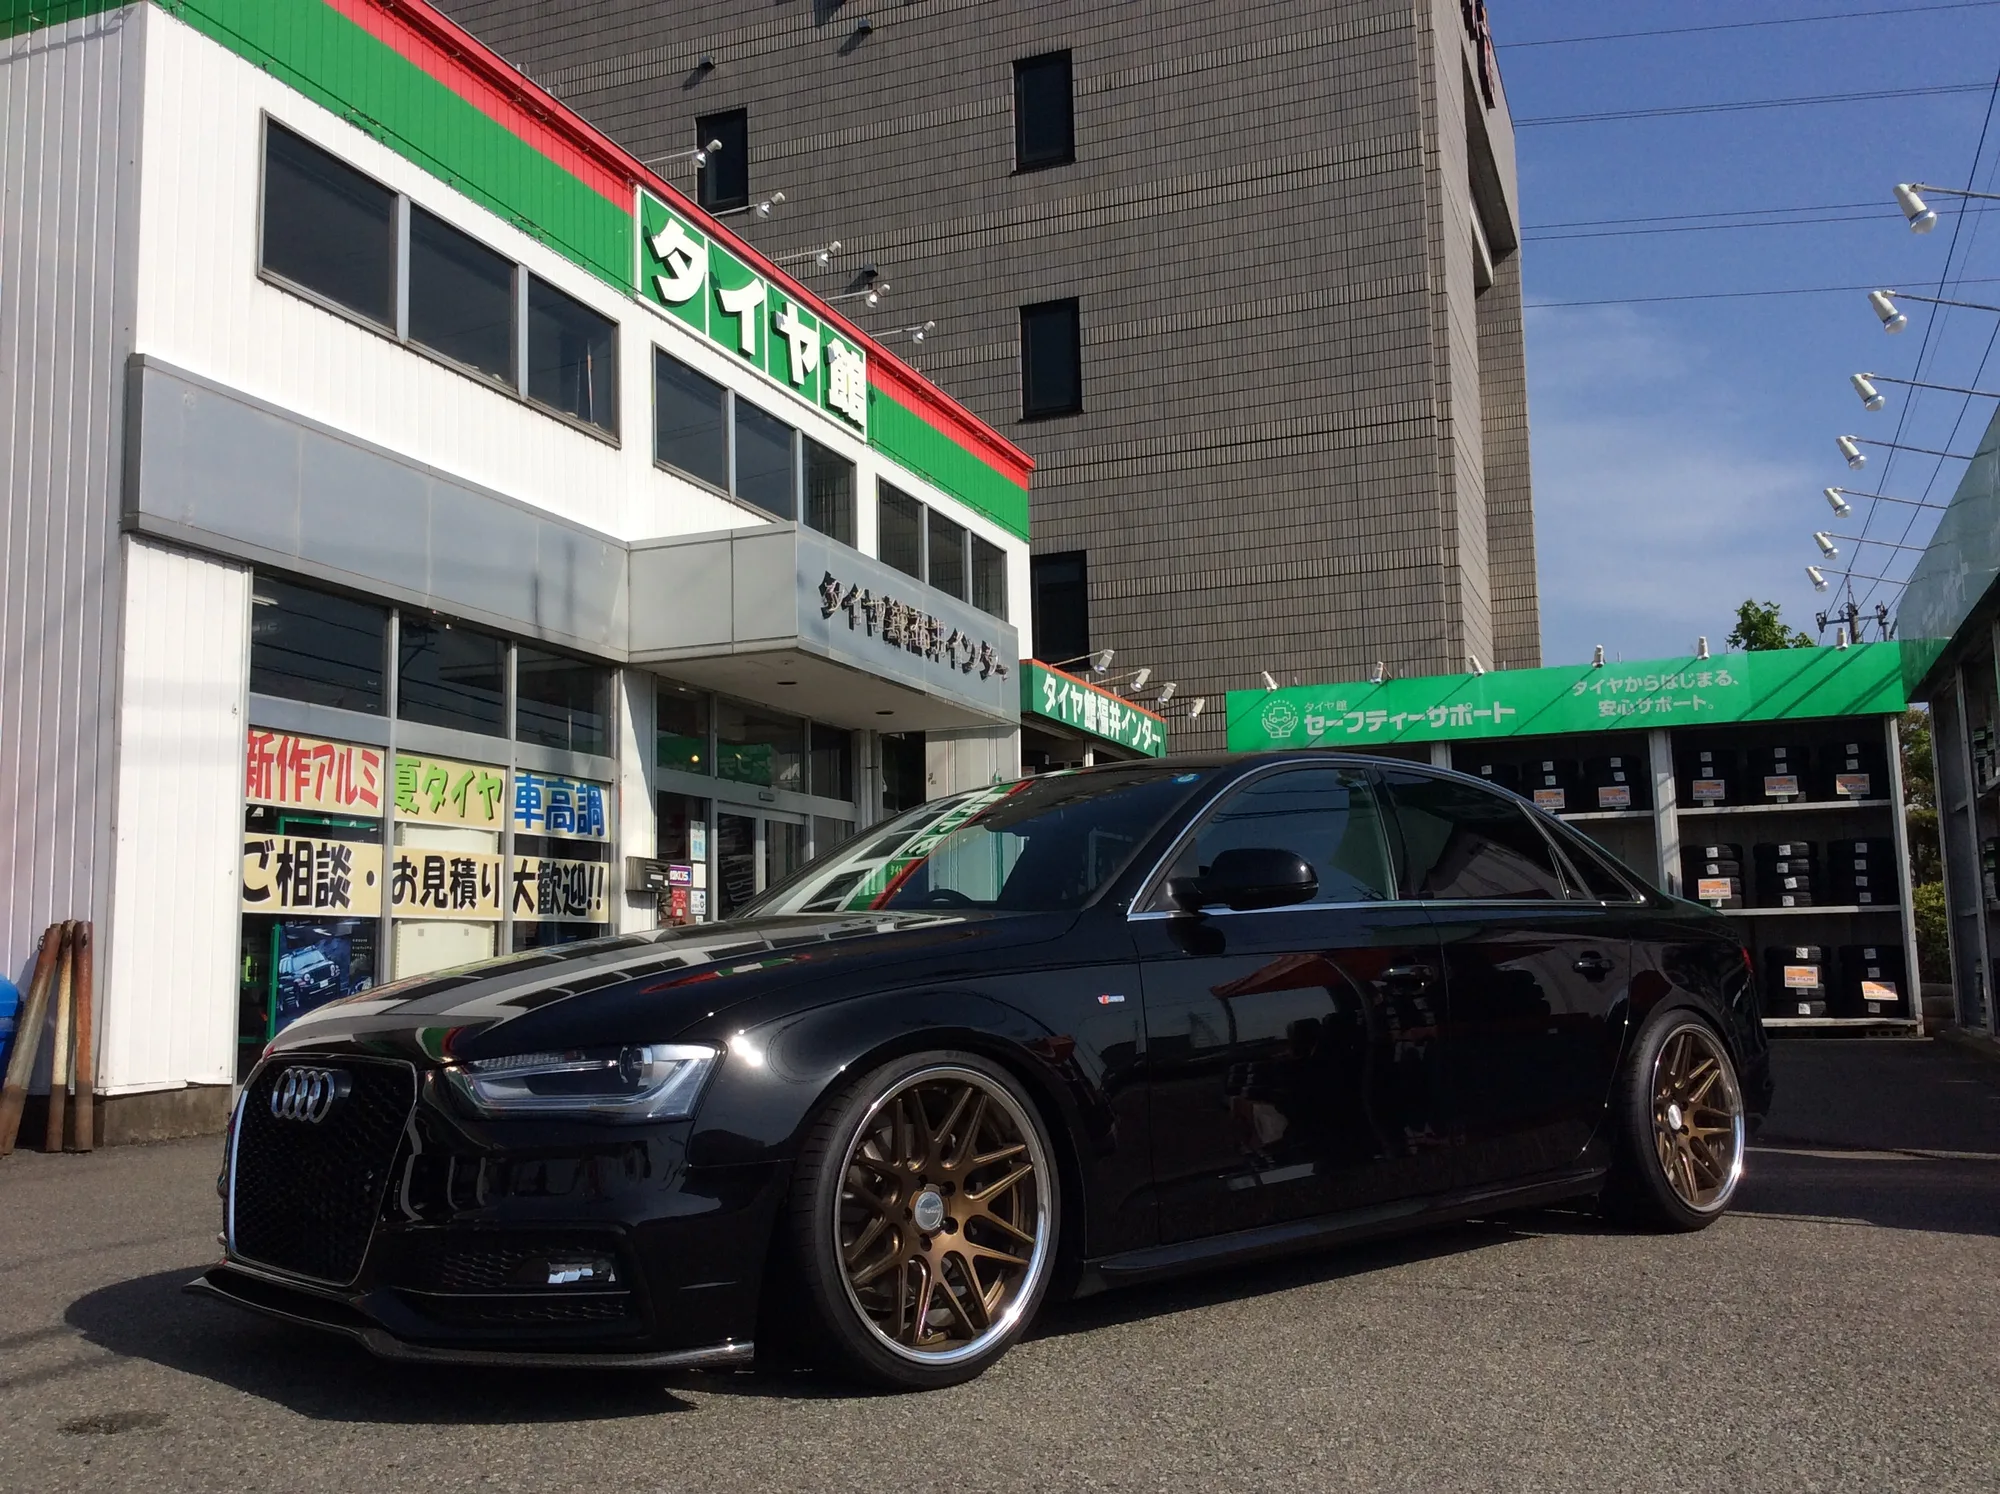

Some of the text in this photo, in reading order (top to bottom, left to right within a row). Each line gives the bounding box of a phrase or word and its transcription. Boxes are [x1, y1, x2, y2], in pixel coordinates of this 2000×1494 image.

[651, 217, 865, 427] タイヤ館
[1572, 669, 1739, 697] タイヤからはじまる、
[1598, 694, 1714, 717] 安心サポート。
[1043, 672, 1161, 750] タイヤ館福井インター
[1304, 700, 1347, 713] タイヤ館
[1304, 701, 1516, 736] セーフティーサポート
[246, 729, 605, 837] 新作アルミ 夏タイヤ 車高調
[392, 855, 500, 910] お見積り
